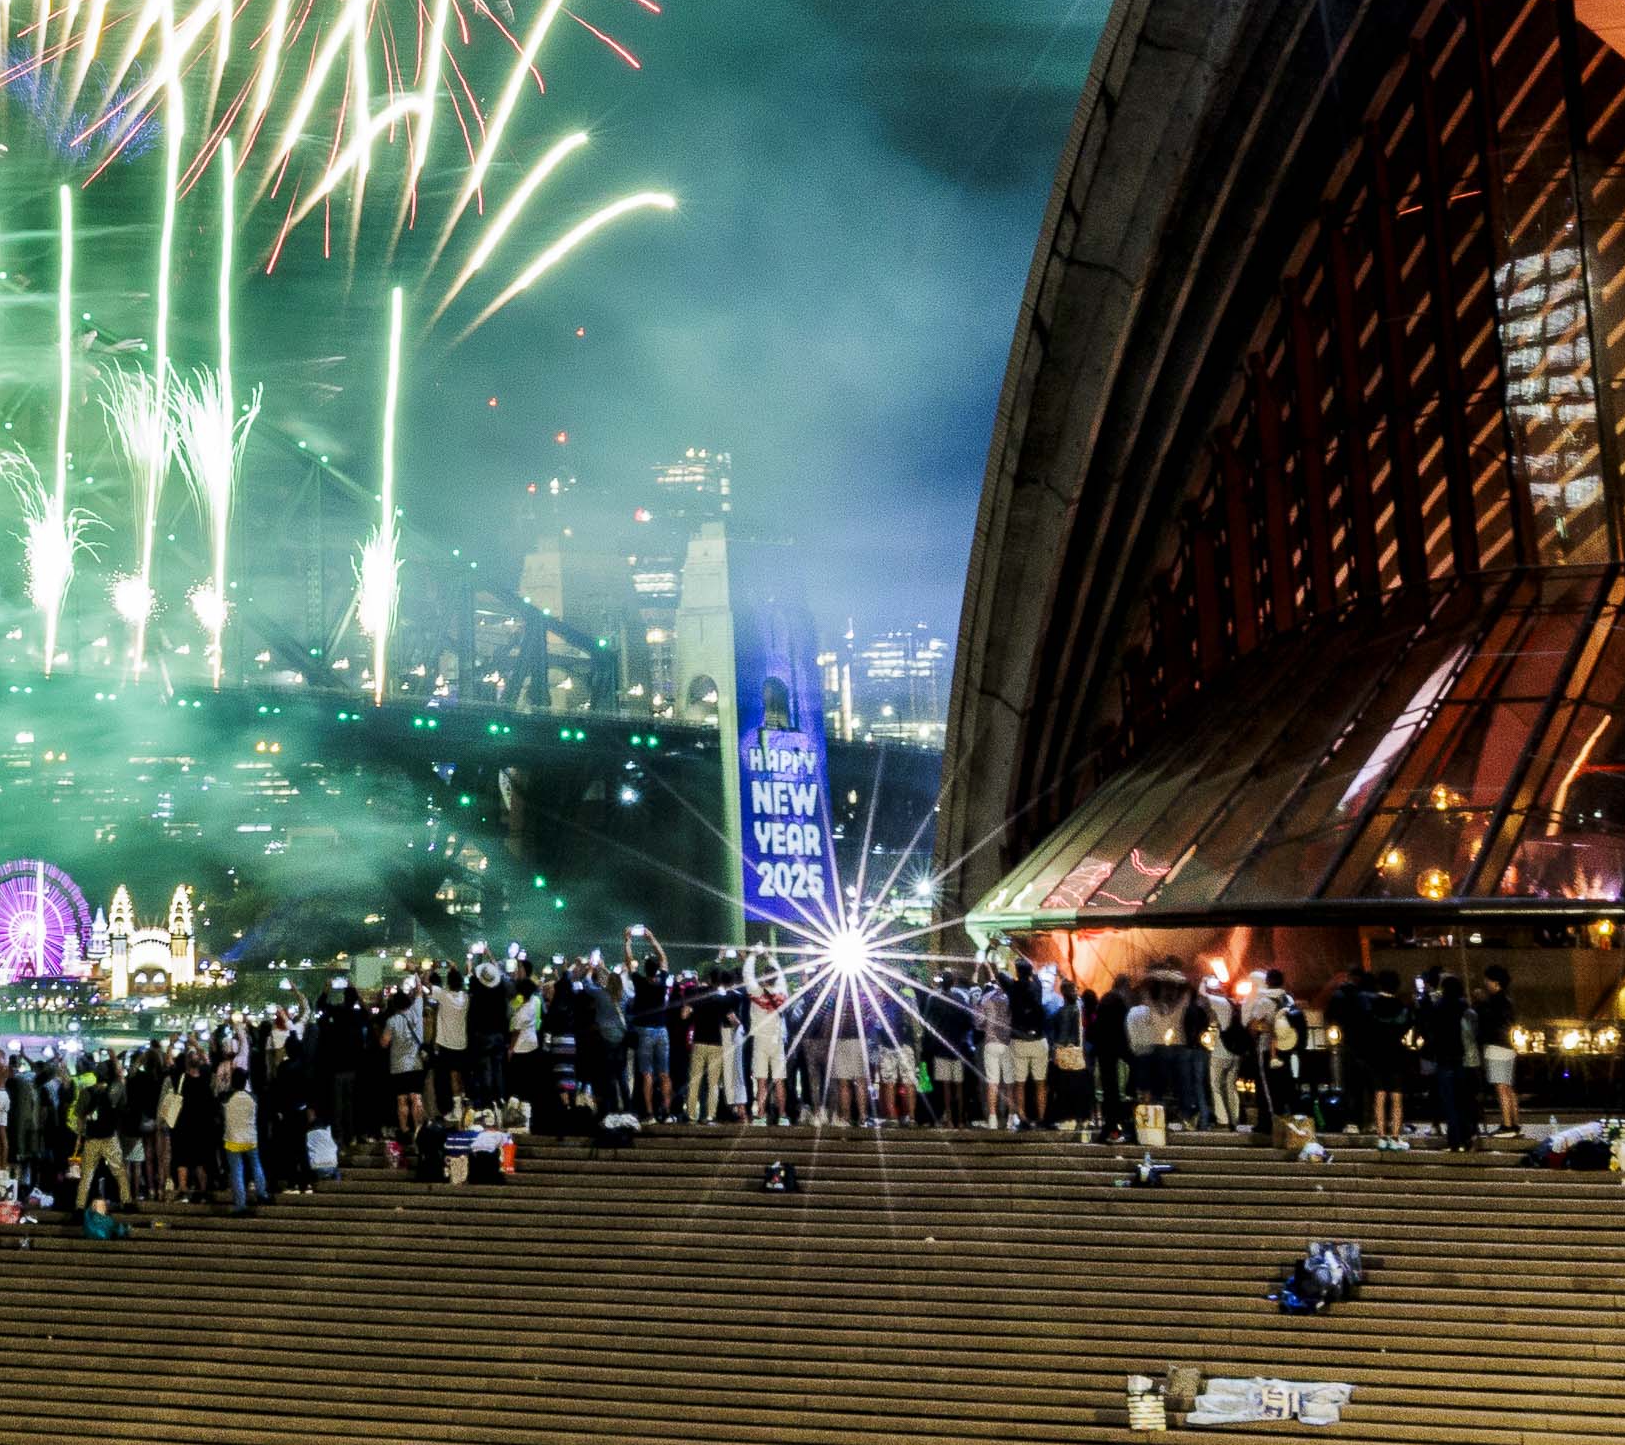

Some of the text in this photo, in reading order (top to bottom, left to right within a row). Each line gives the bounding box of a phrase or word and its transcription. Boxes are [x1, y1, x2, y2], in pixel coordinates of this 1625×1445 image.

[749, 748, 817, 775] HAPPY
[751, 781, 818, 816] NEW
[753, 821, 822, 856] YEAR
[756, 862, 825, 898] 2025
